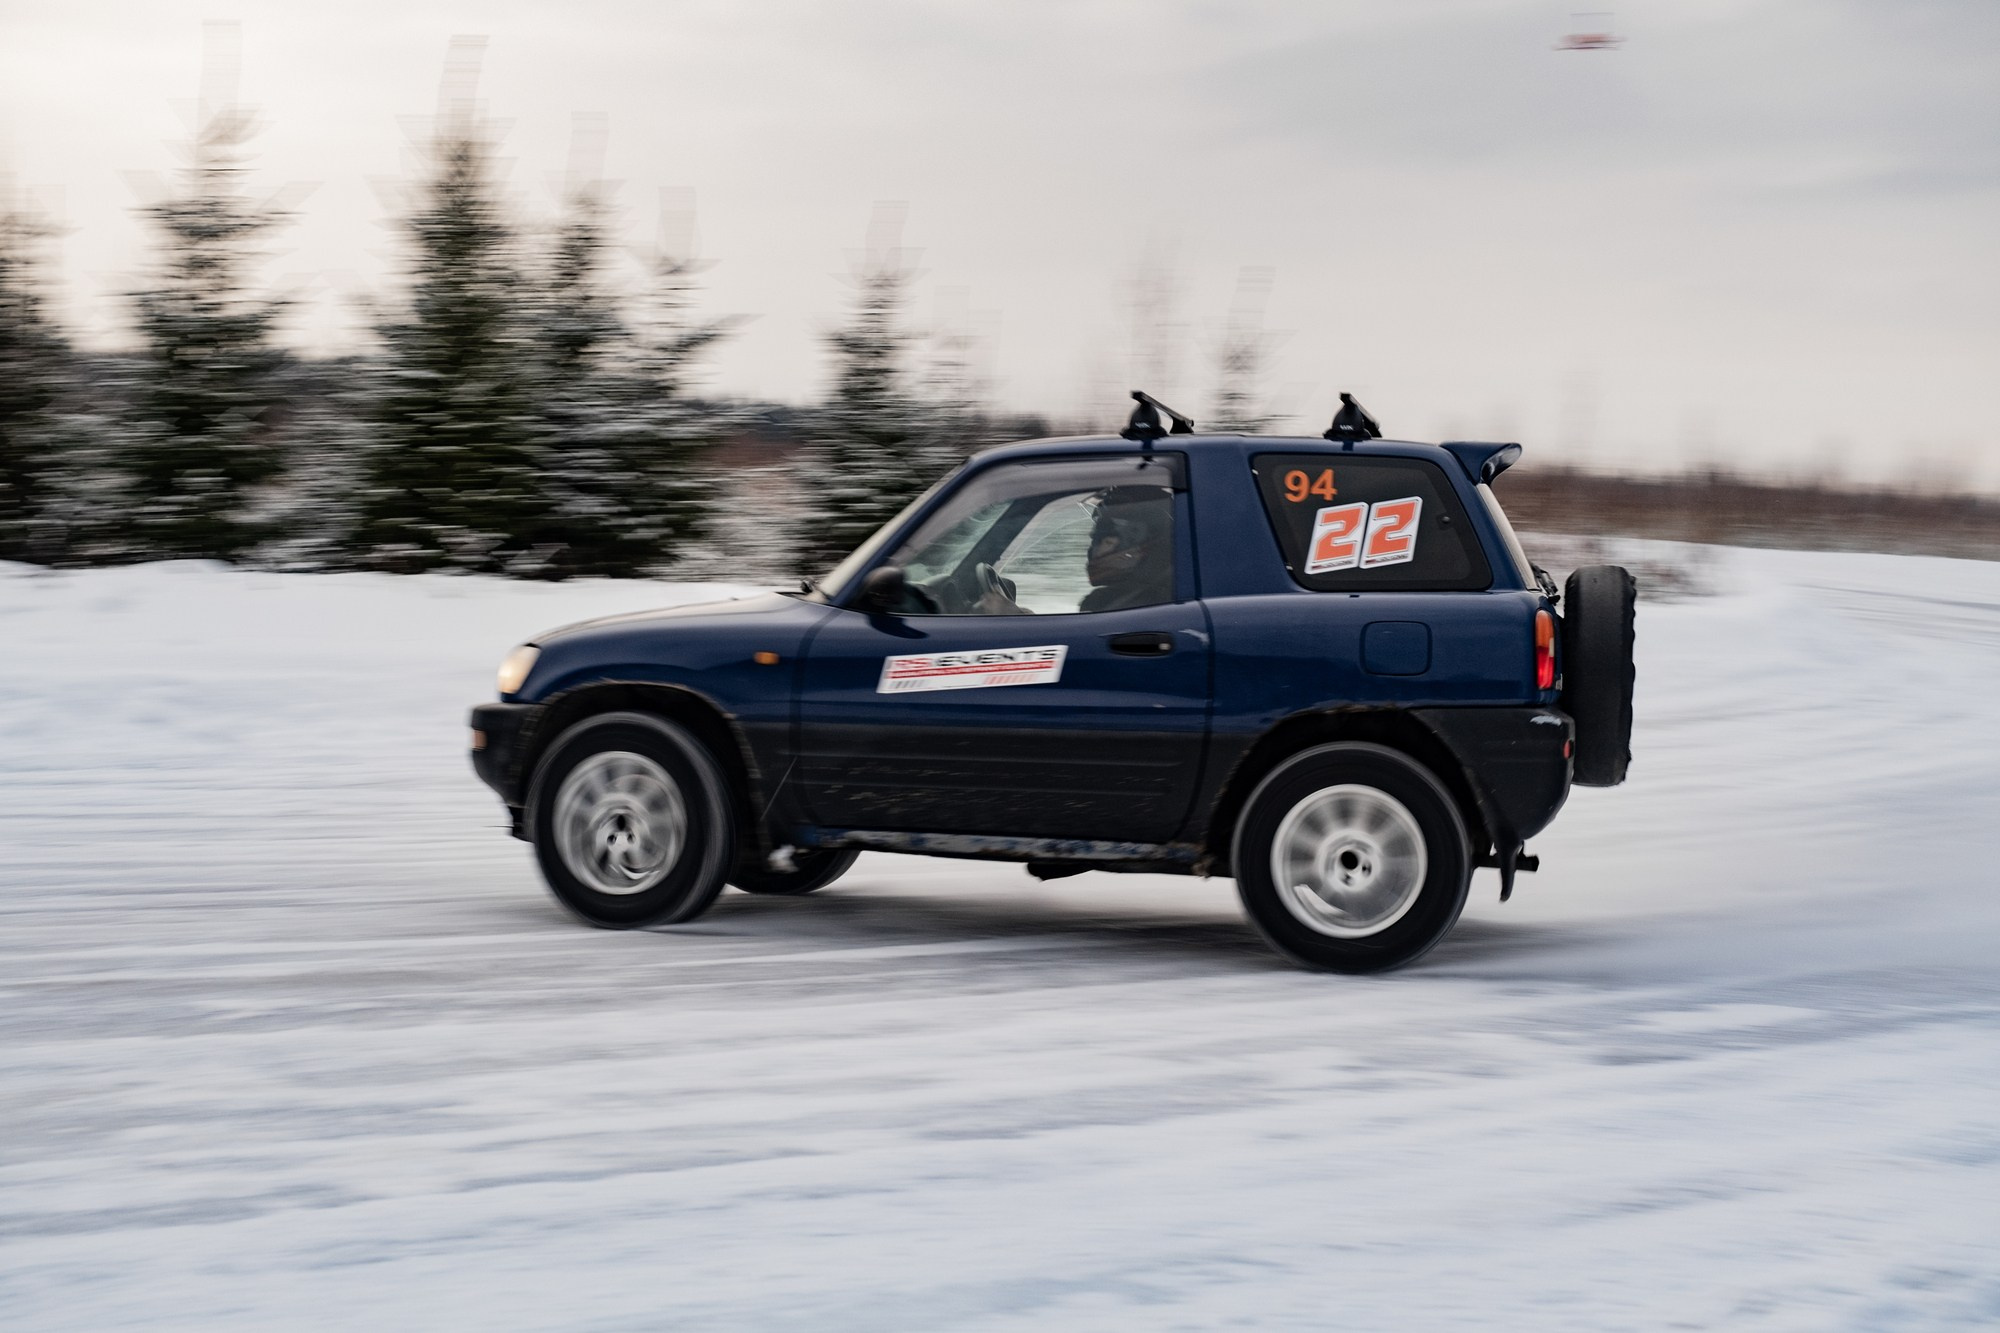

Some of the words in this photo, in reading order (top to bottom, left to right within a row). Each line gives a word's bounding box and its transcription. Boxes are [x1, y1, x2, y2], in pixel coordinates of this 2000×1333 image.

[1283, 468, 1338, 503] 94
[1313, 500, 1417, 562] 22
[936, 649, 1059, 667] EVENTS
